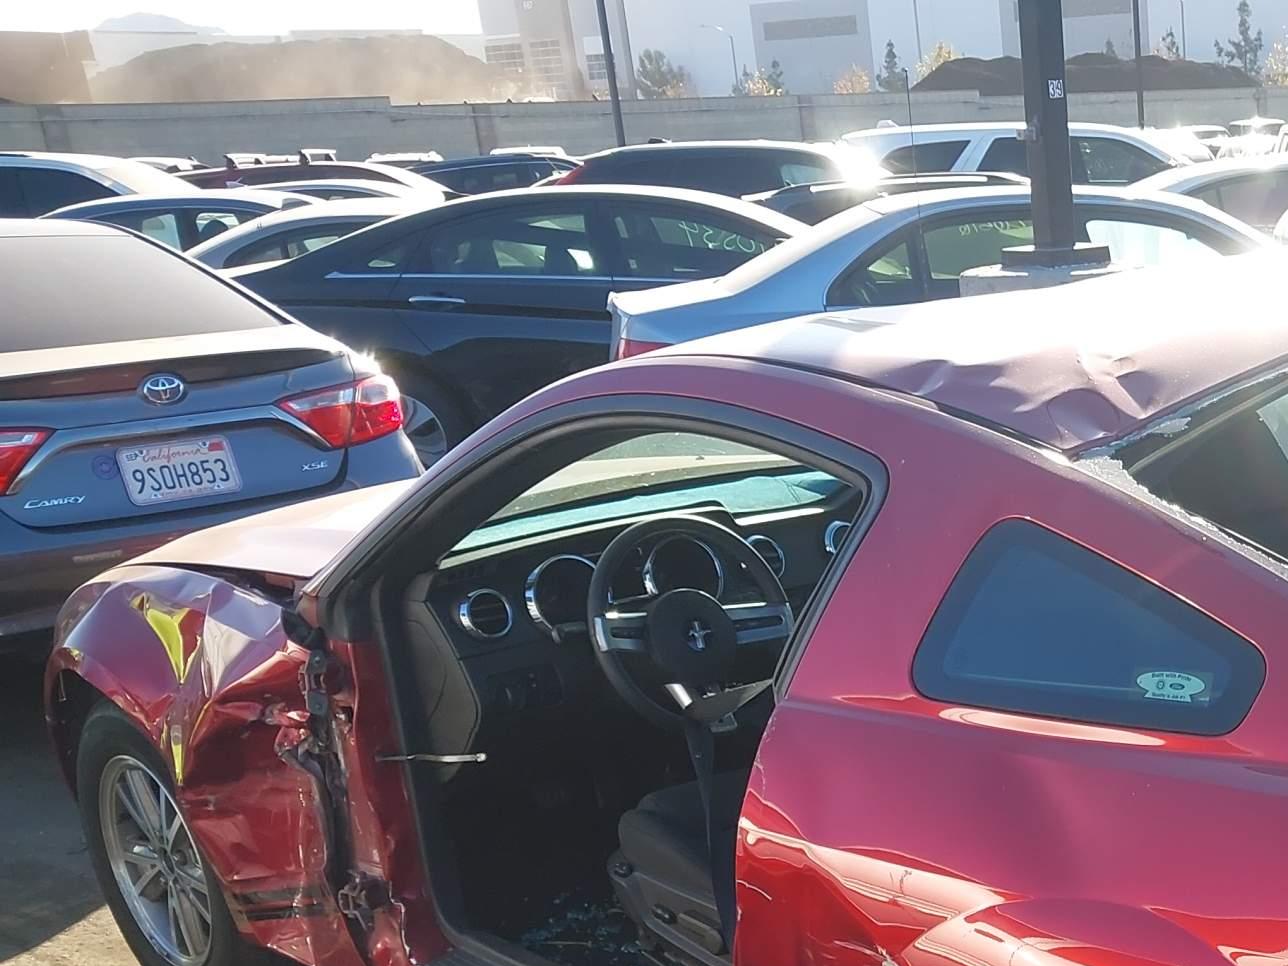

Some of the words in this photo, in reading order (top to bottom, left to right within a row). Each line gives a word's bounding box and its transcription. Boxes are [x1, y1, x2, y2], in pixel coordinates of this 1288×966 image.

[1049, 80, 1063, 98] 39
[142, 447, 208, 463] California
[302, 460, 328, 471] XSE
[132, 458, 230, 494] 9SOH853
[23, 495, 86, 509] CAMRY
